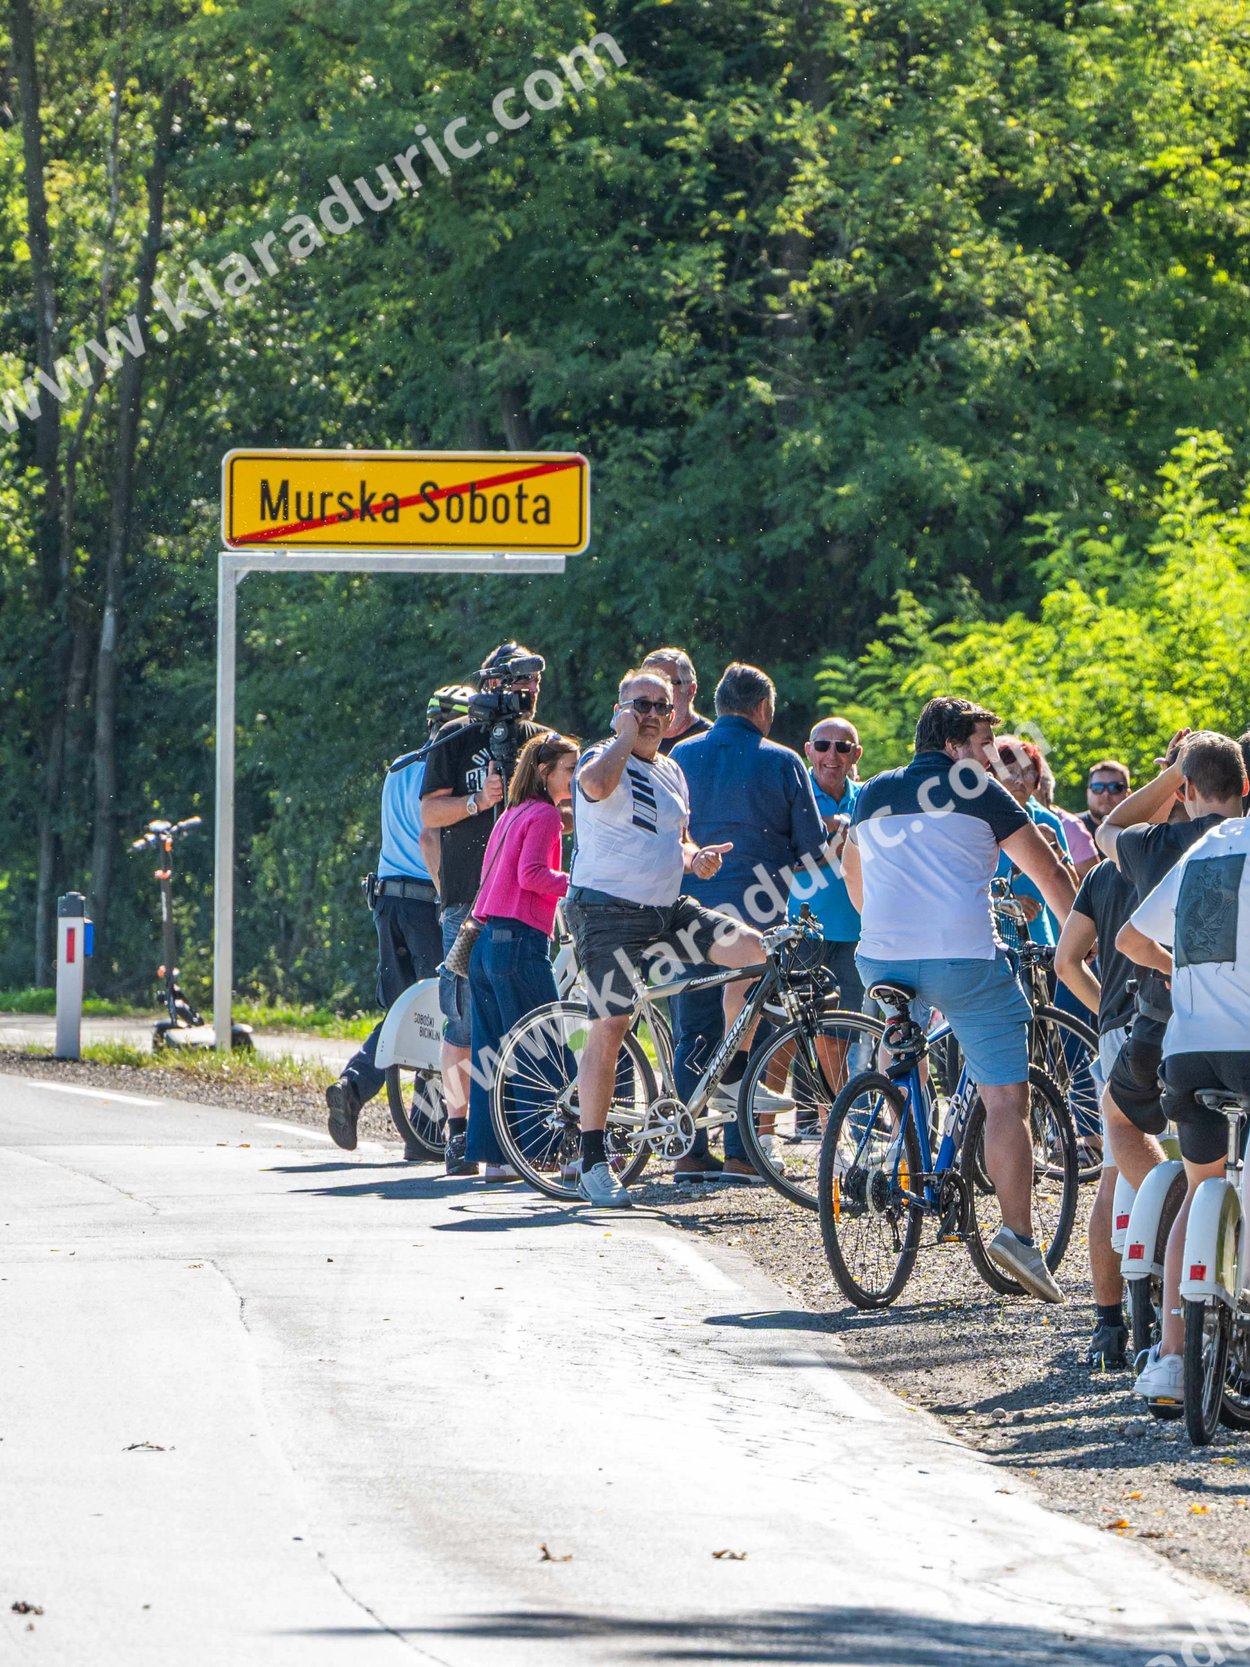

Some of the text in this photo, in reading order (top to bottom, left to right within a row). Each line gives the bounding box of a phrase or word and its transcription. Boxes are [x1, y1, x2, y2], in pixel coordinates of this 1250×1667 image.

[260, 479, 551, 525] Murska Sobota
[709, 1002, 754, 1077] MERIDA
